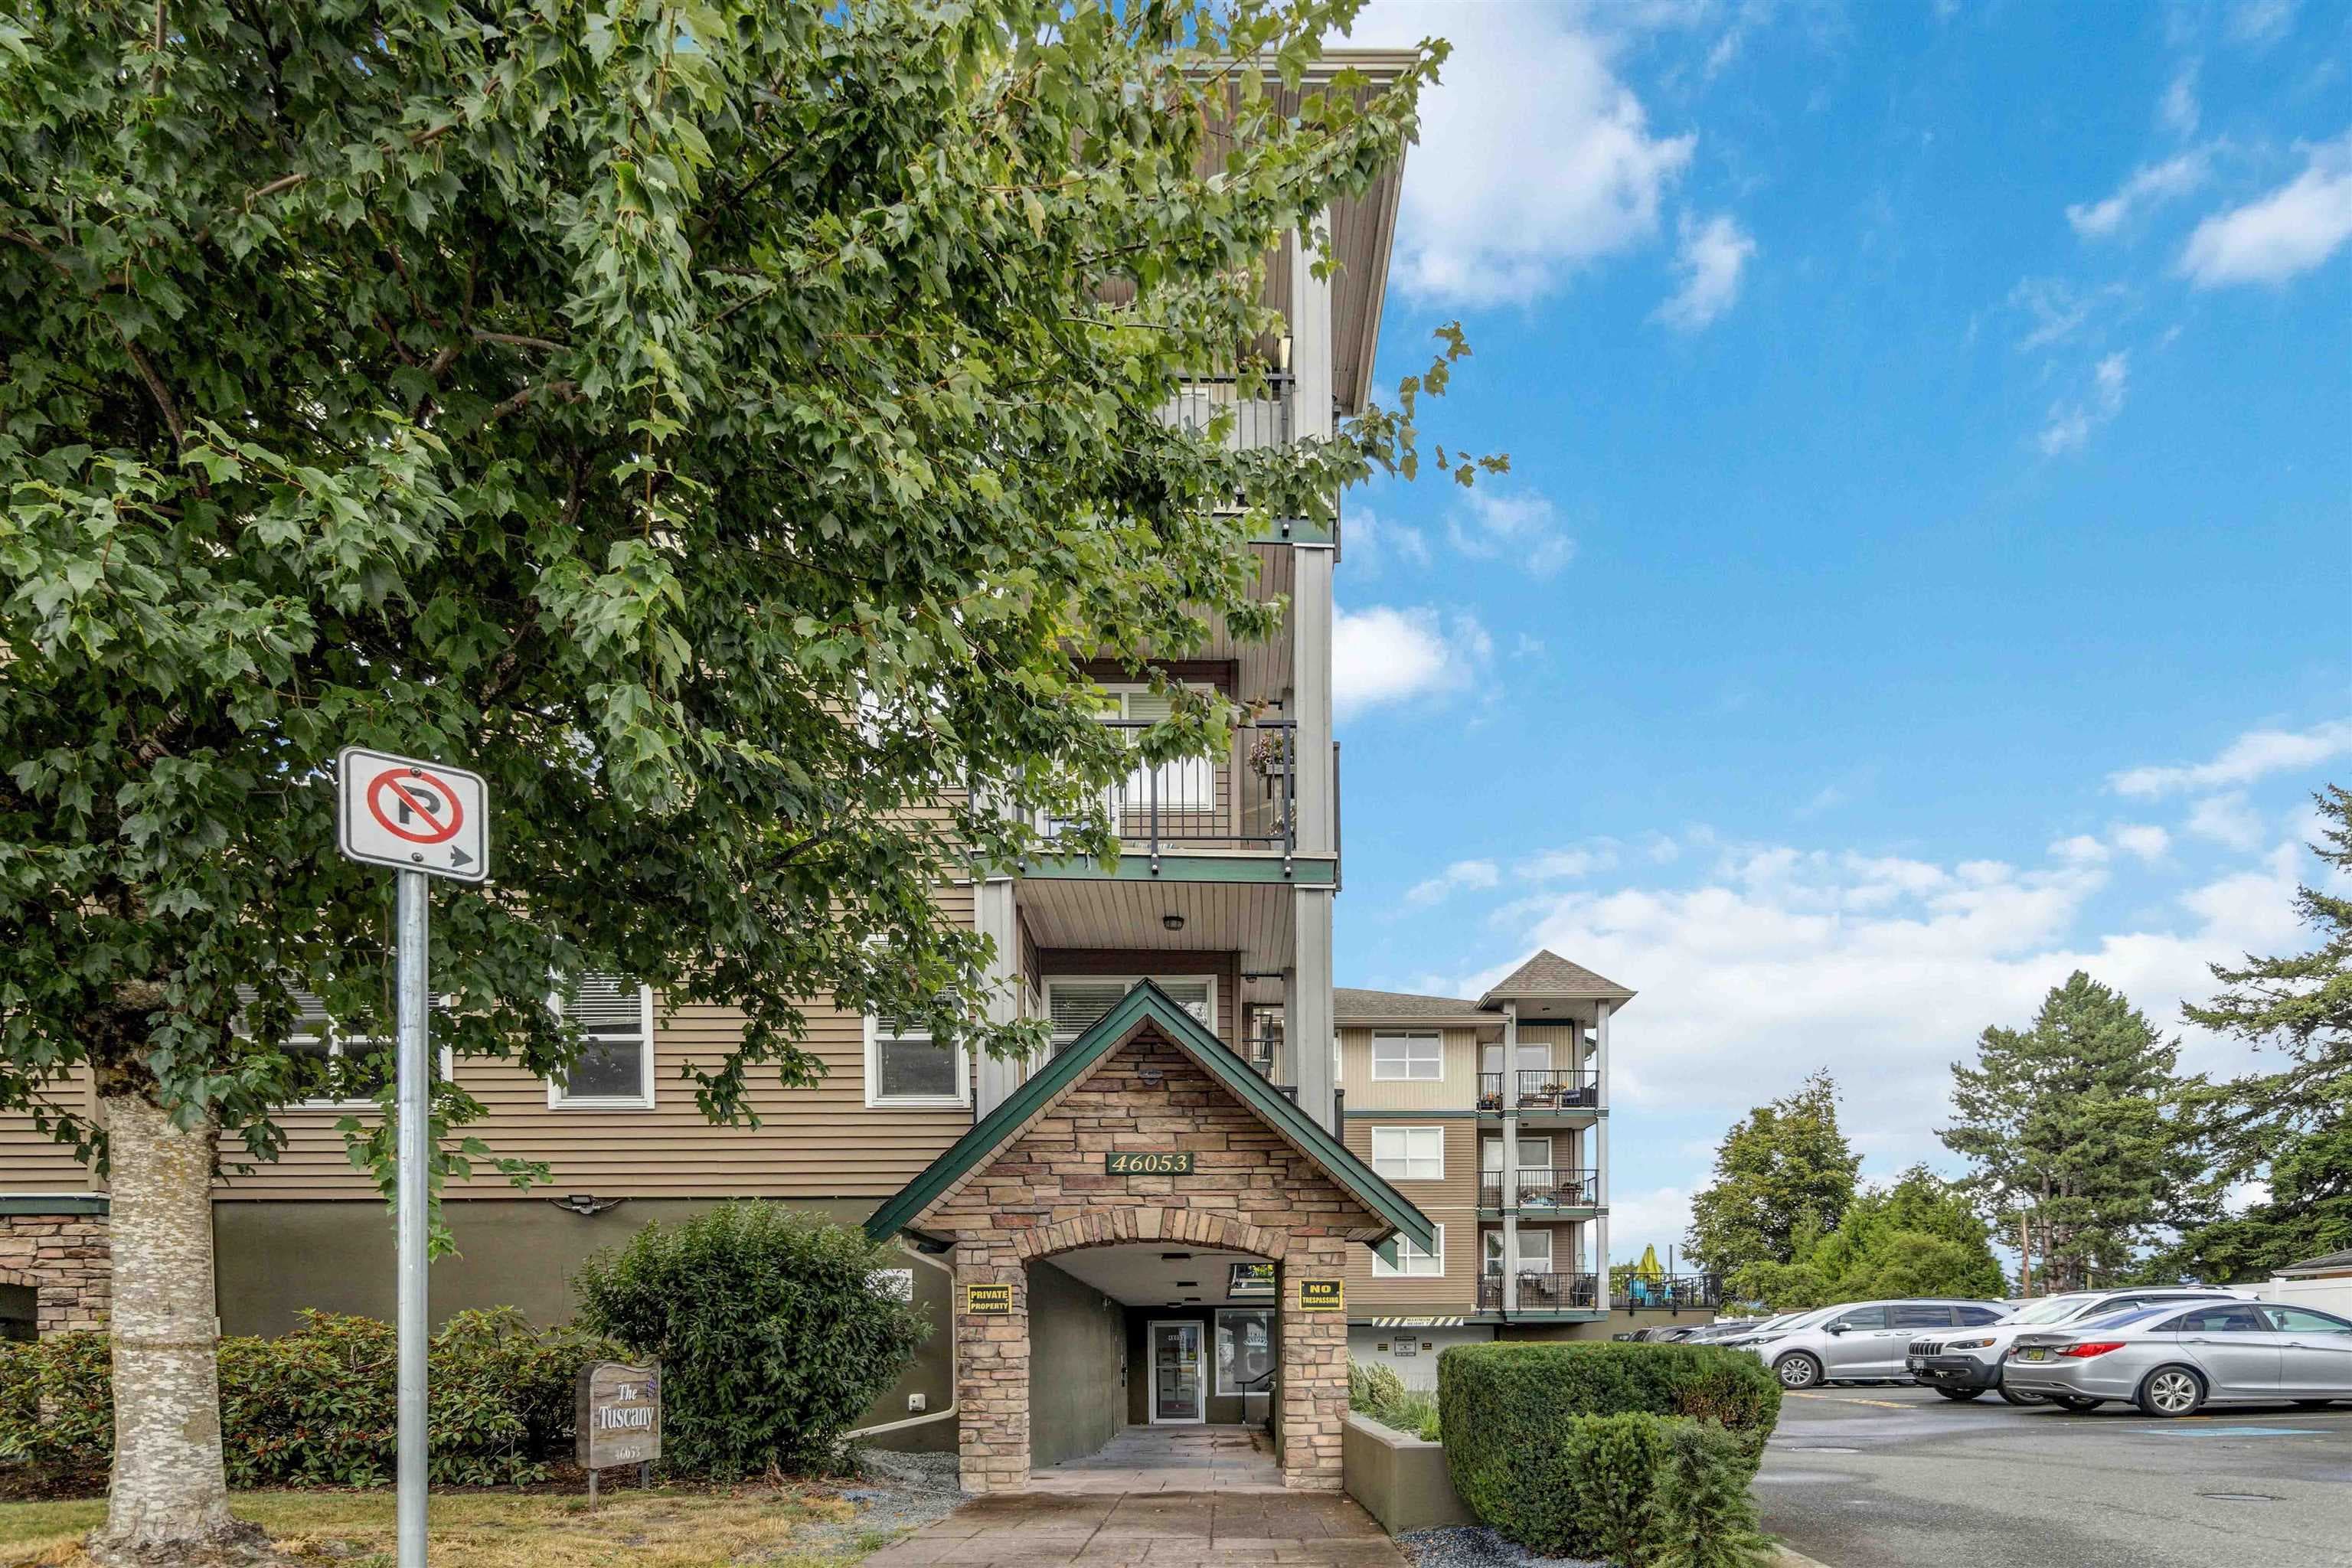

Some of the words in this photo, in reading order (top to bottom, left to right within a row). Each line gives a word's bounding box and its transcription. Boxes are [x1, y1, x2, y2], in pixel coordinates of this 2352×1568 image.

[1112, 1155, 1187, 1172] 46053
[971, 1290, 1008, 1299] PRIVATE
[1310, 1285, 1331, 1293] NO
[619, 1384, 637, 1400] The
[599, 1404, 654, 1432] Tuscany
